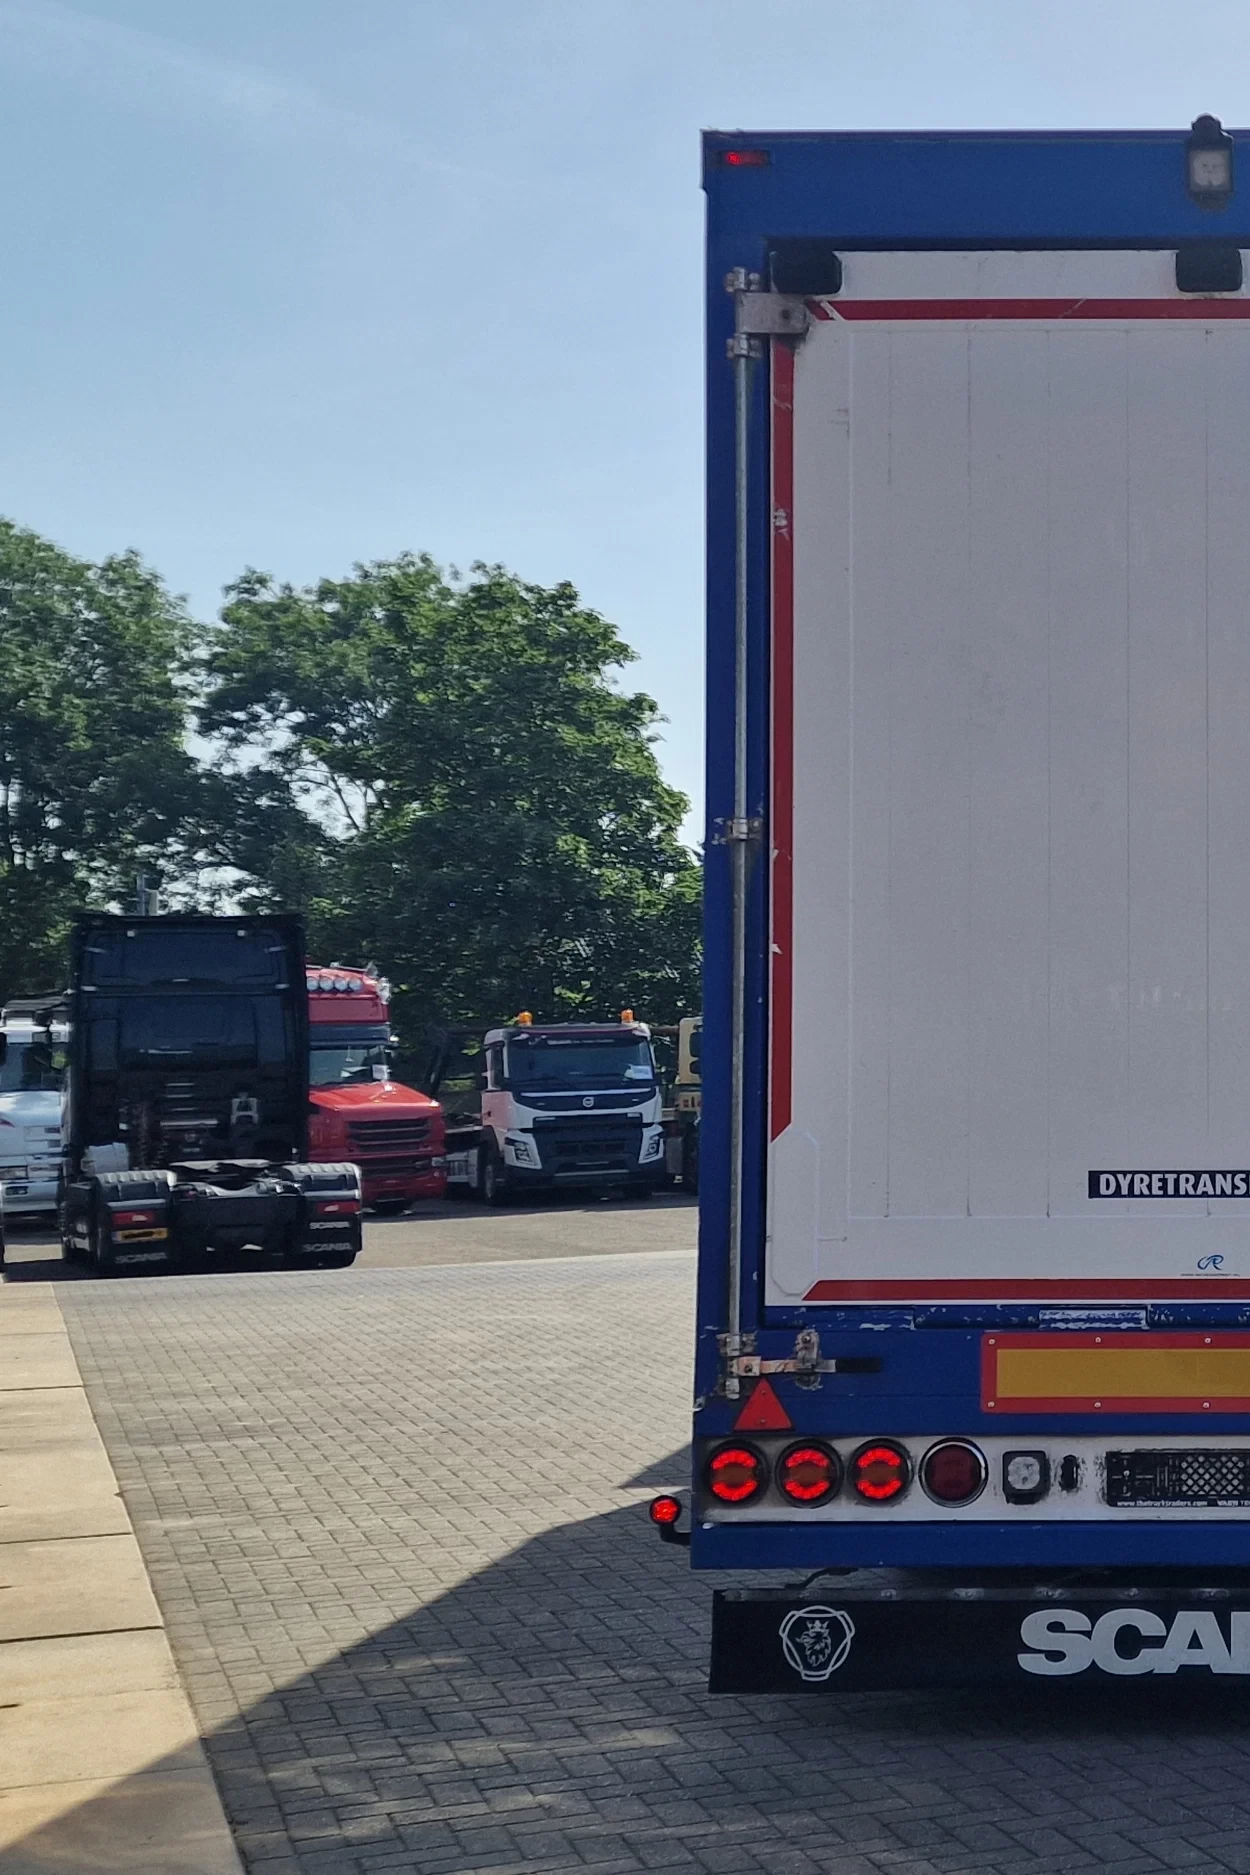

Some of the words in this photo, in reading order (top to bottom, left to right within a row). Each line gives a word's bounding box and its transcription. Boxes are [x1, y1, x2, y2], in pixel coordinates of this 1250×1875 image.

[309, 1221, 351, 1230] SCANIA
[303, 1242, 353, 1253] SCANIA
[114, 1252, 169, 1264] SCANIA
